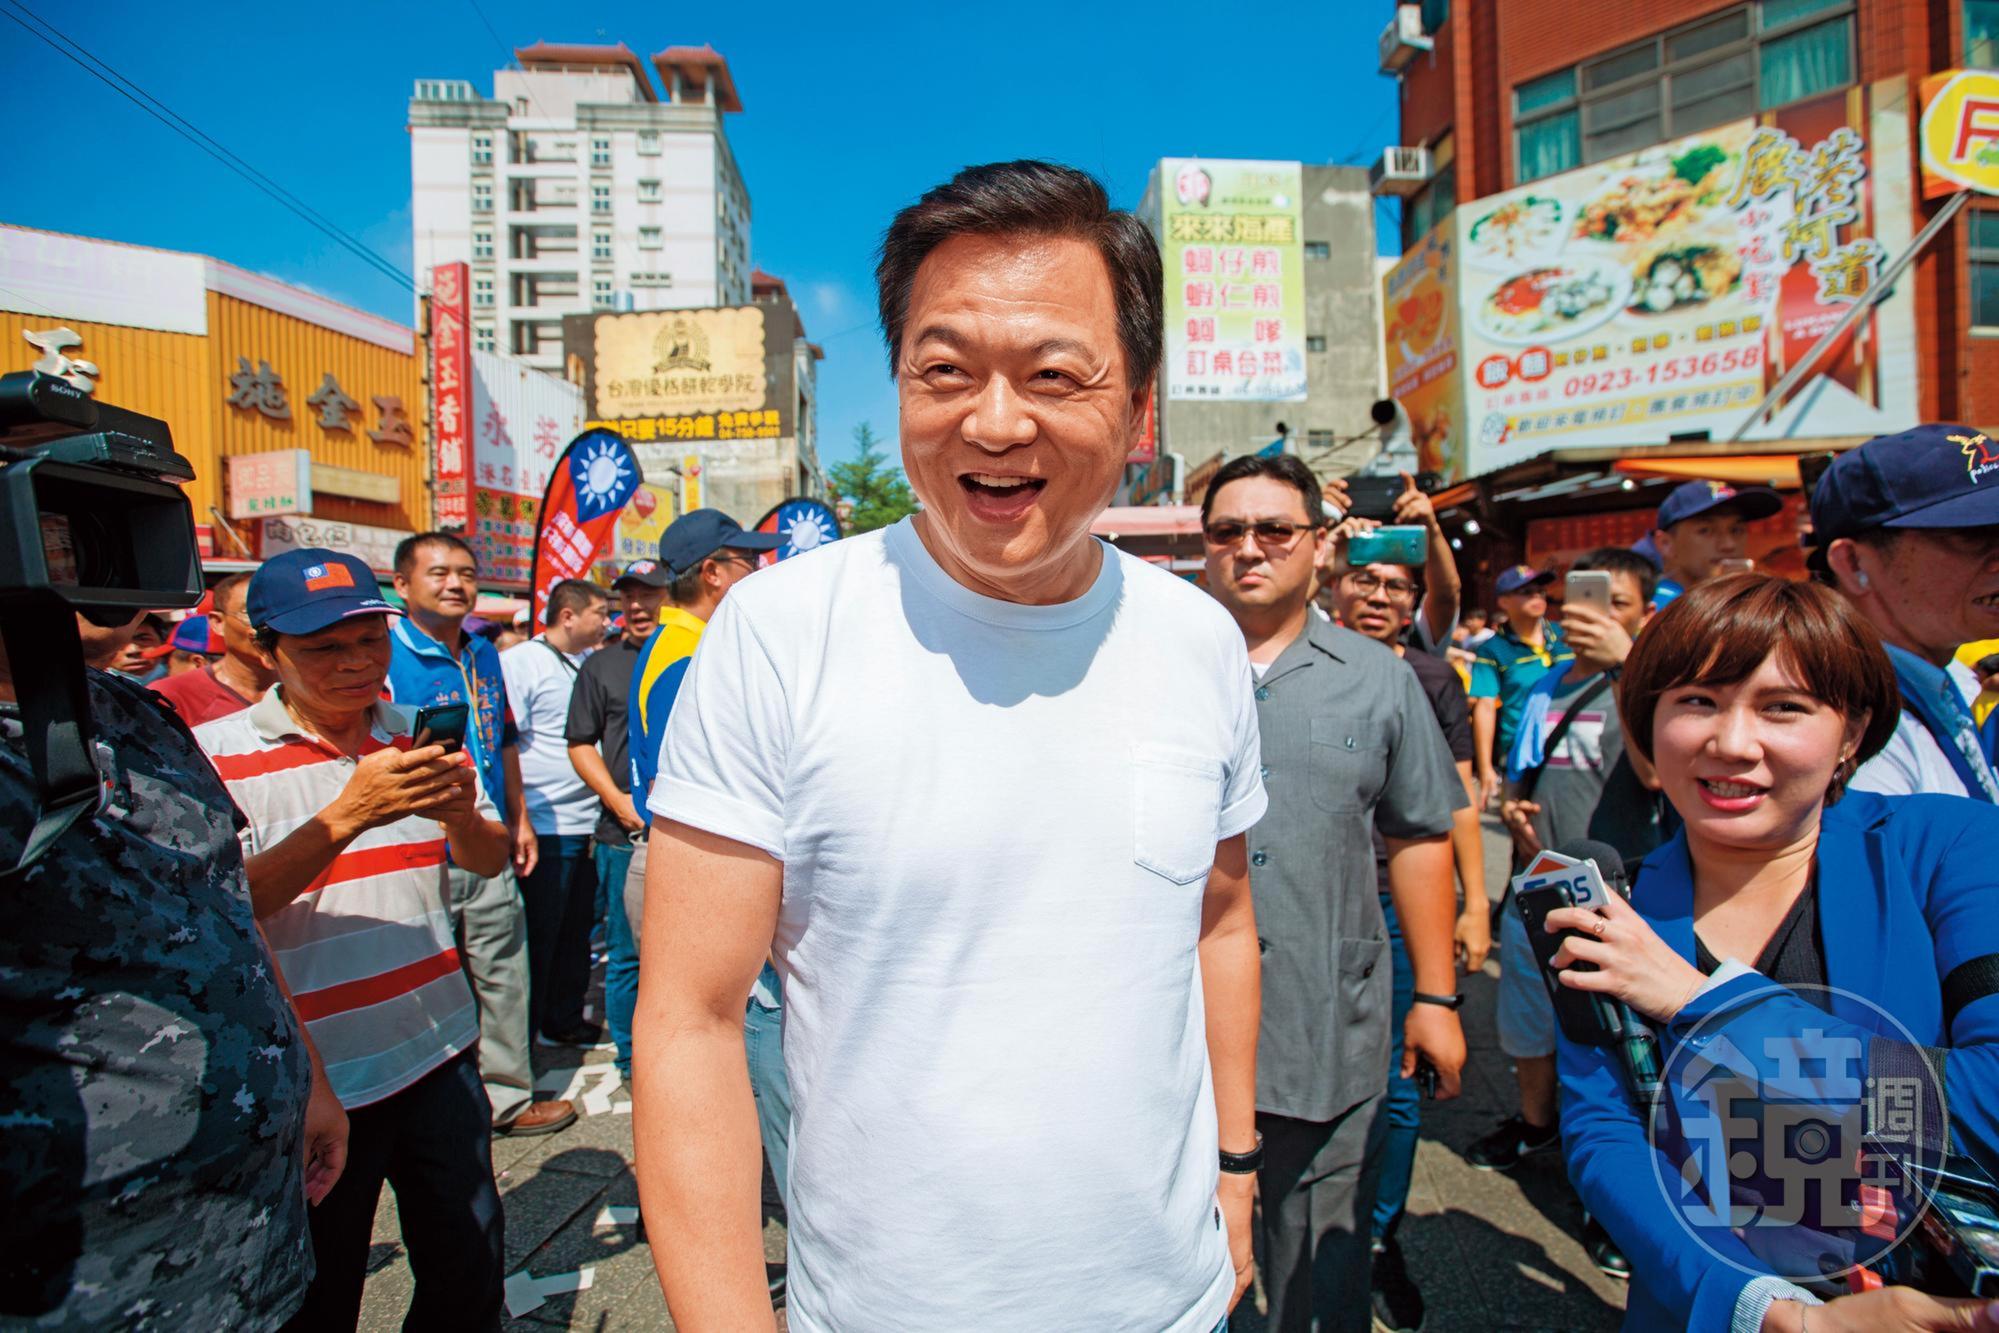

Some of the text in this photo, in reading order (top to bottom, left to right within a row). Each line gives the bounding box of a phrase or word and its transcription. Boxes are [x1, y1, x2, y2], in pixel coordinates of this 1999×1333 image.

[1184, 248, 1280, 274] 蚵仔煎
[1563, 345, 1761, 398] 0923-153658
[226, 356, 415, 447] 施金玉
